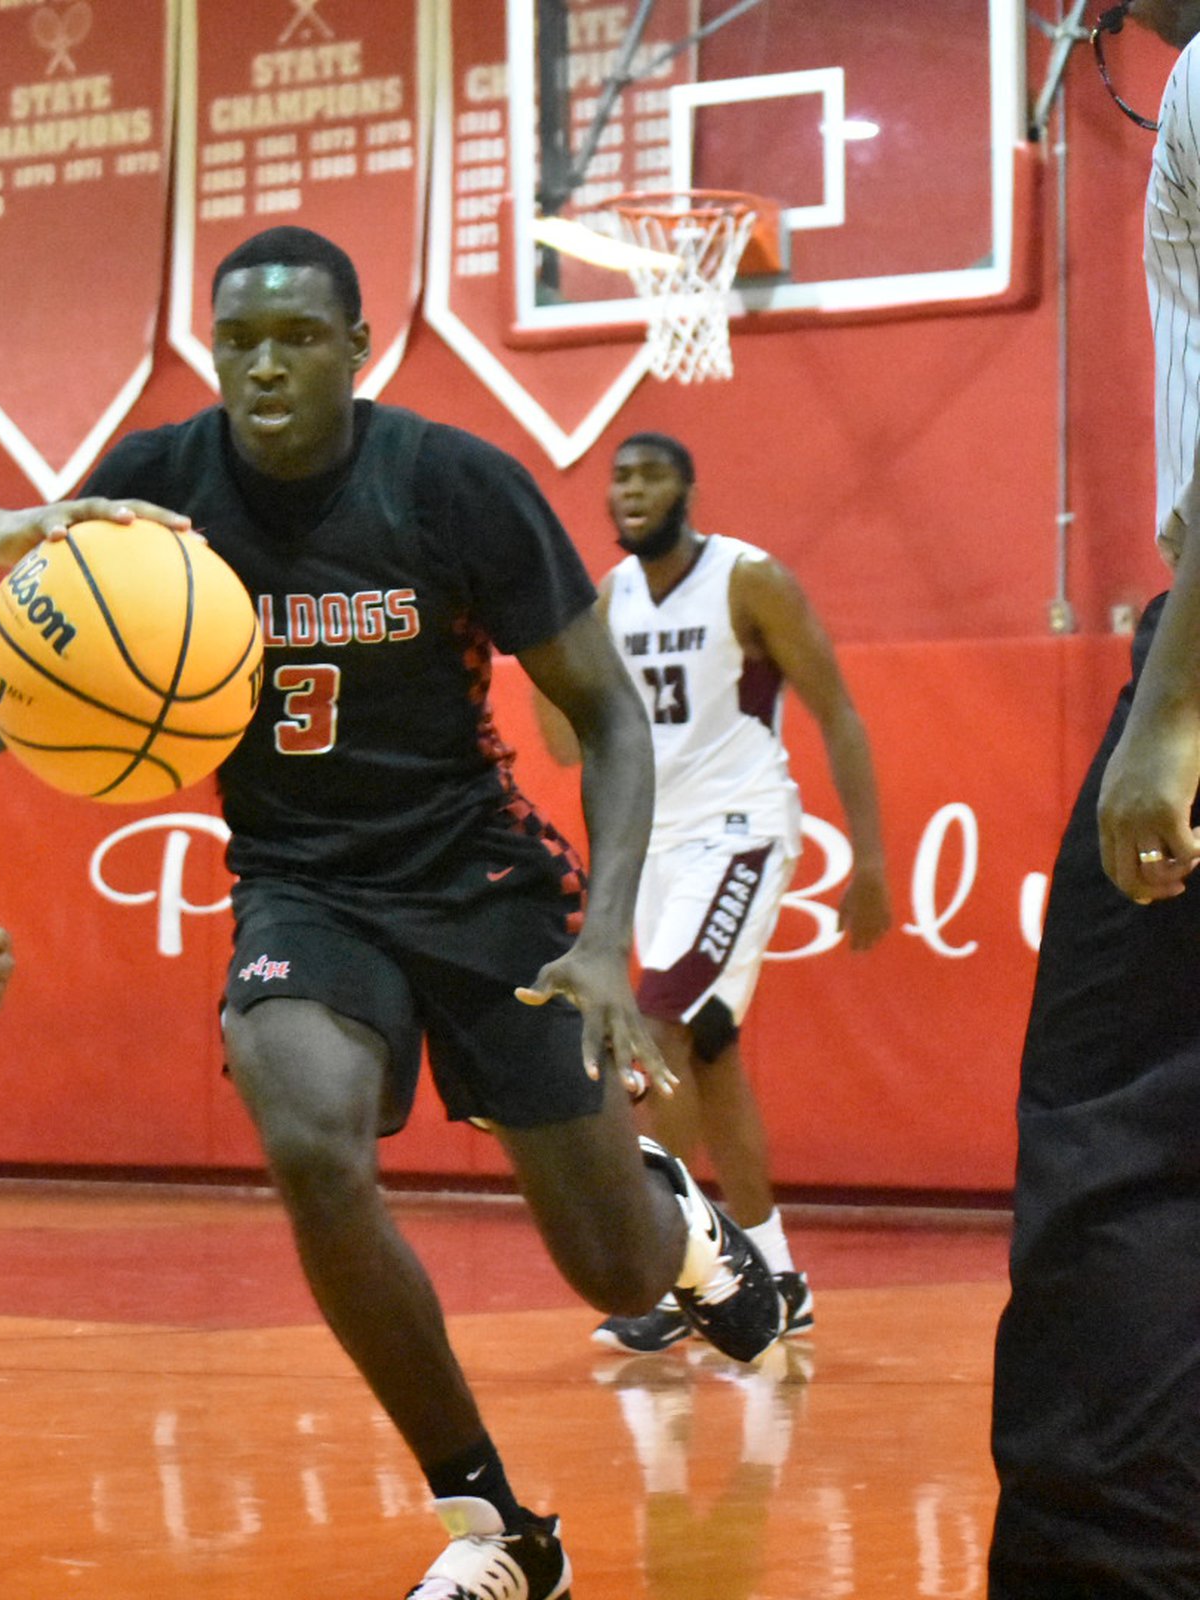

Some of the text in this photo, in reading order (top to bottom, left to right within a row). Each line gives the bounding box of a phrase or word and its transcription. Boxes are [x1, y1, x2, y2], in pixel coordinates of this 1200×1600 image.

[11, 74, 112, 119] STATE
[252, 40, 362, 88] STATE
[210, 74, 404, 134] CHAMPIONS
[8, 552, 76, 657] ilson
[273, 663, 341, 755] 3
[699, 862, 759, 965] ZEBRAS
